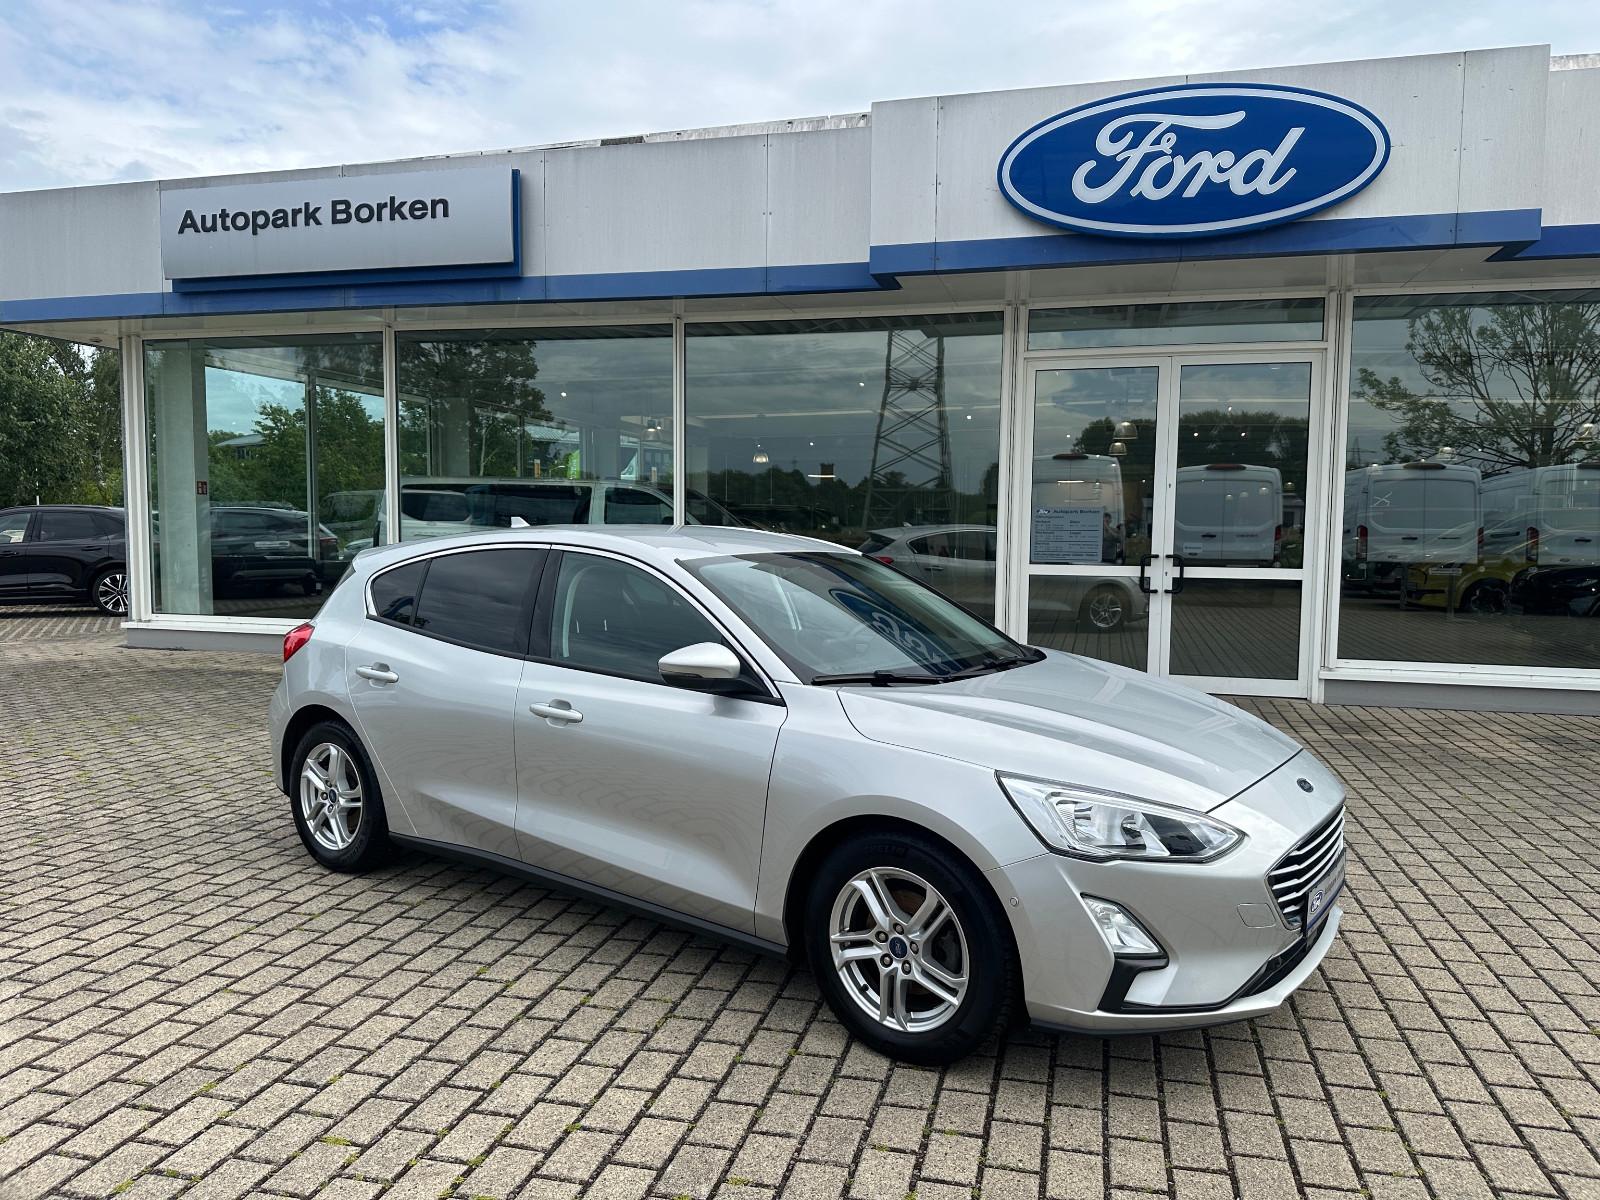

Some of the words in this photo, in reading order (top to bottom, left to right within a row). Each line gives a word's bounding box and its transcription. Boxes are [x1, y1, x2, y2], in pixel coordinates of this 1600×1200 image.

[1072, 110, 1306, 204] Ford
[177, 202, 323, 236] Autopark
[331, 195, 450, 225] Borken
